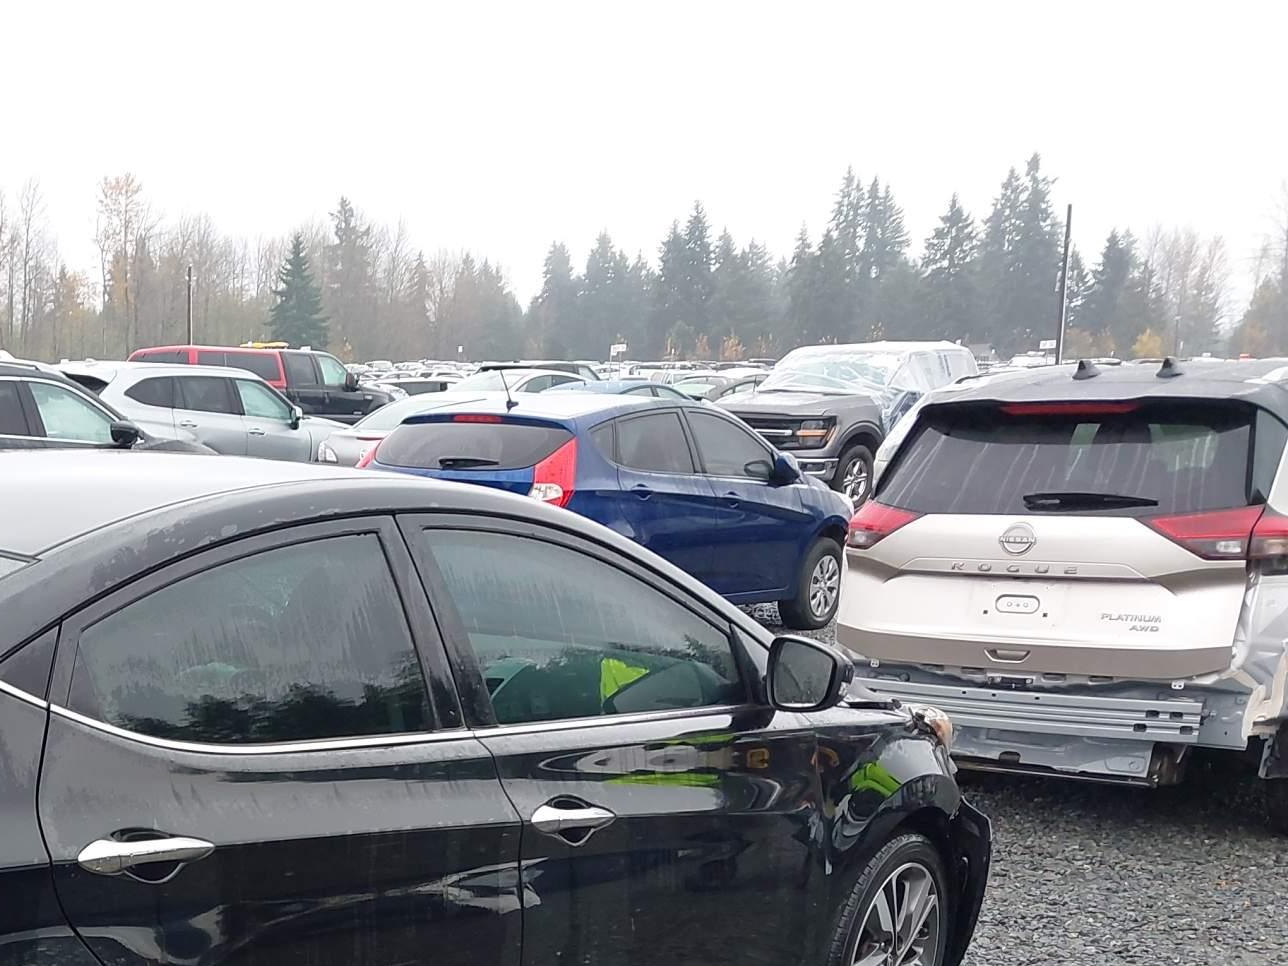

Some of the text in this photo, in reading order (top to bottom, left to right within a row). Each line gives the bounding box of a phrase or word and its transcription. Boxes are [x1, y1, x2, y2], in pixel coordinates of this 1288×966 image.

[998, 535, 1036, 544] NISSAN
[951, 562, 1078, 574] ROGUE
[1101, 613, 1161, 623] PLATINUM
